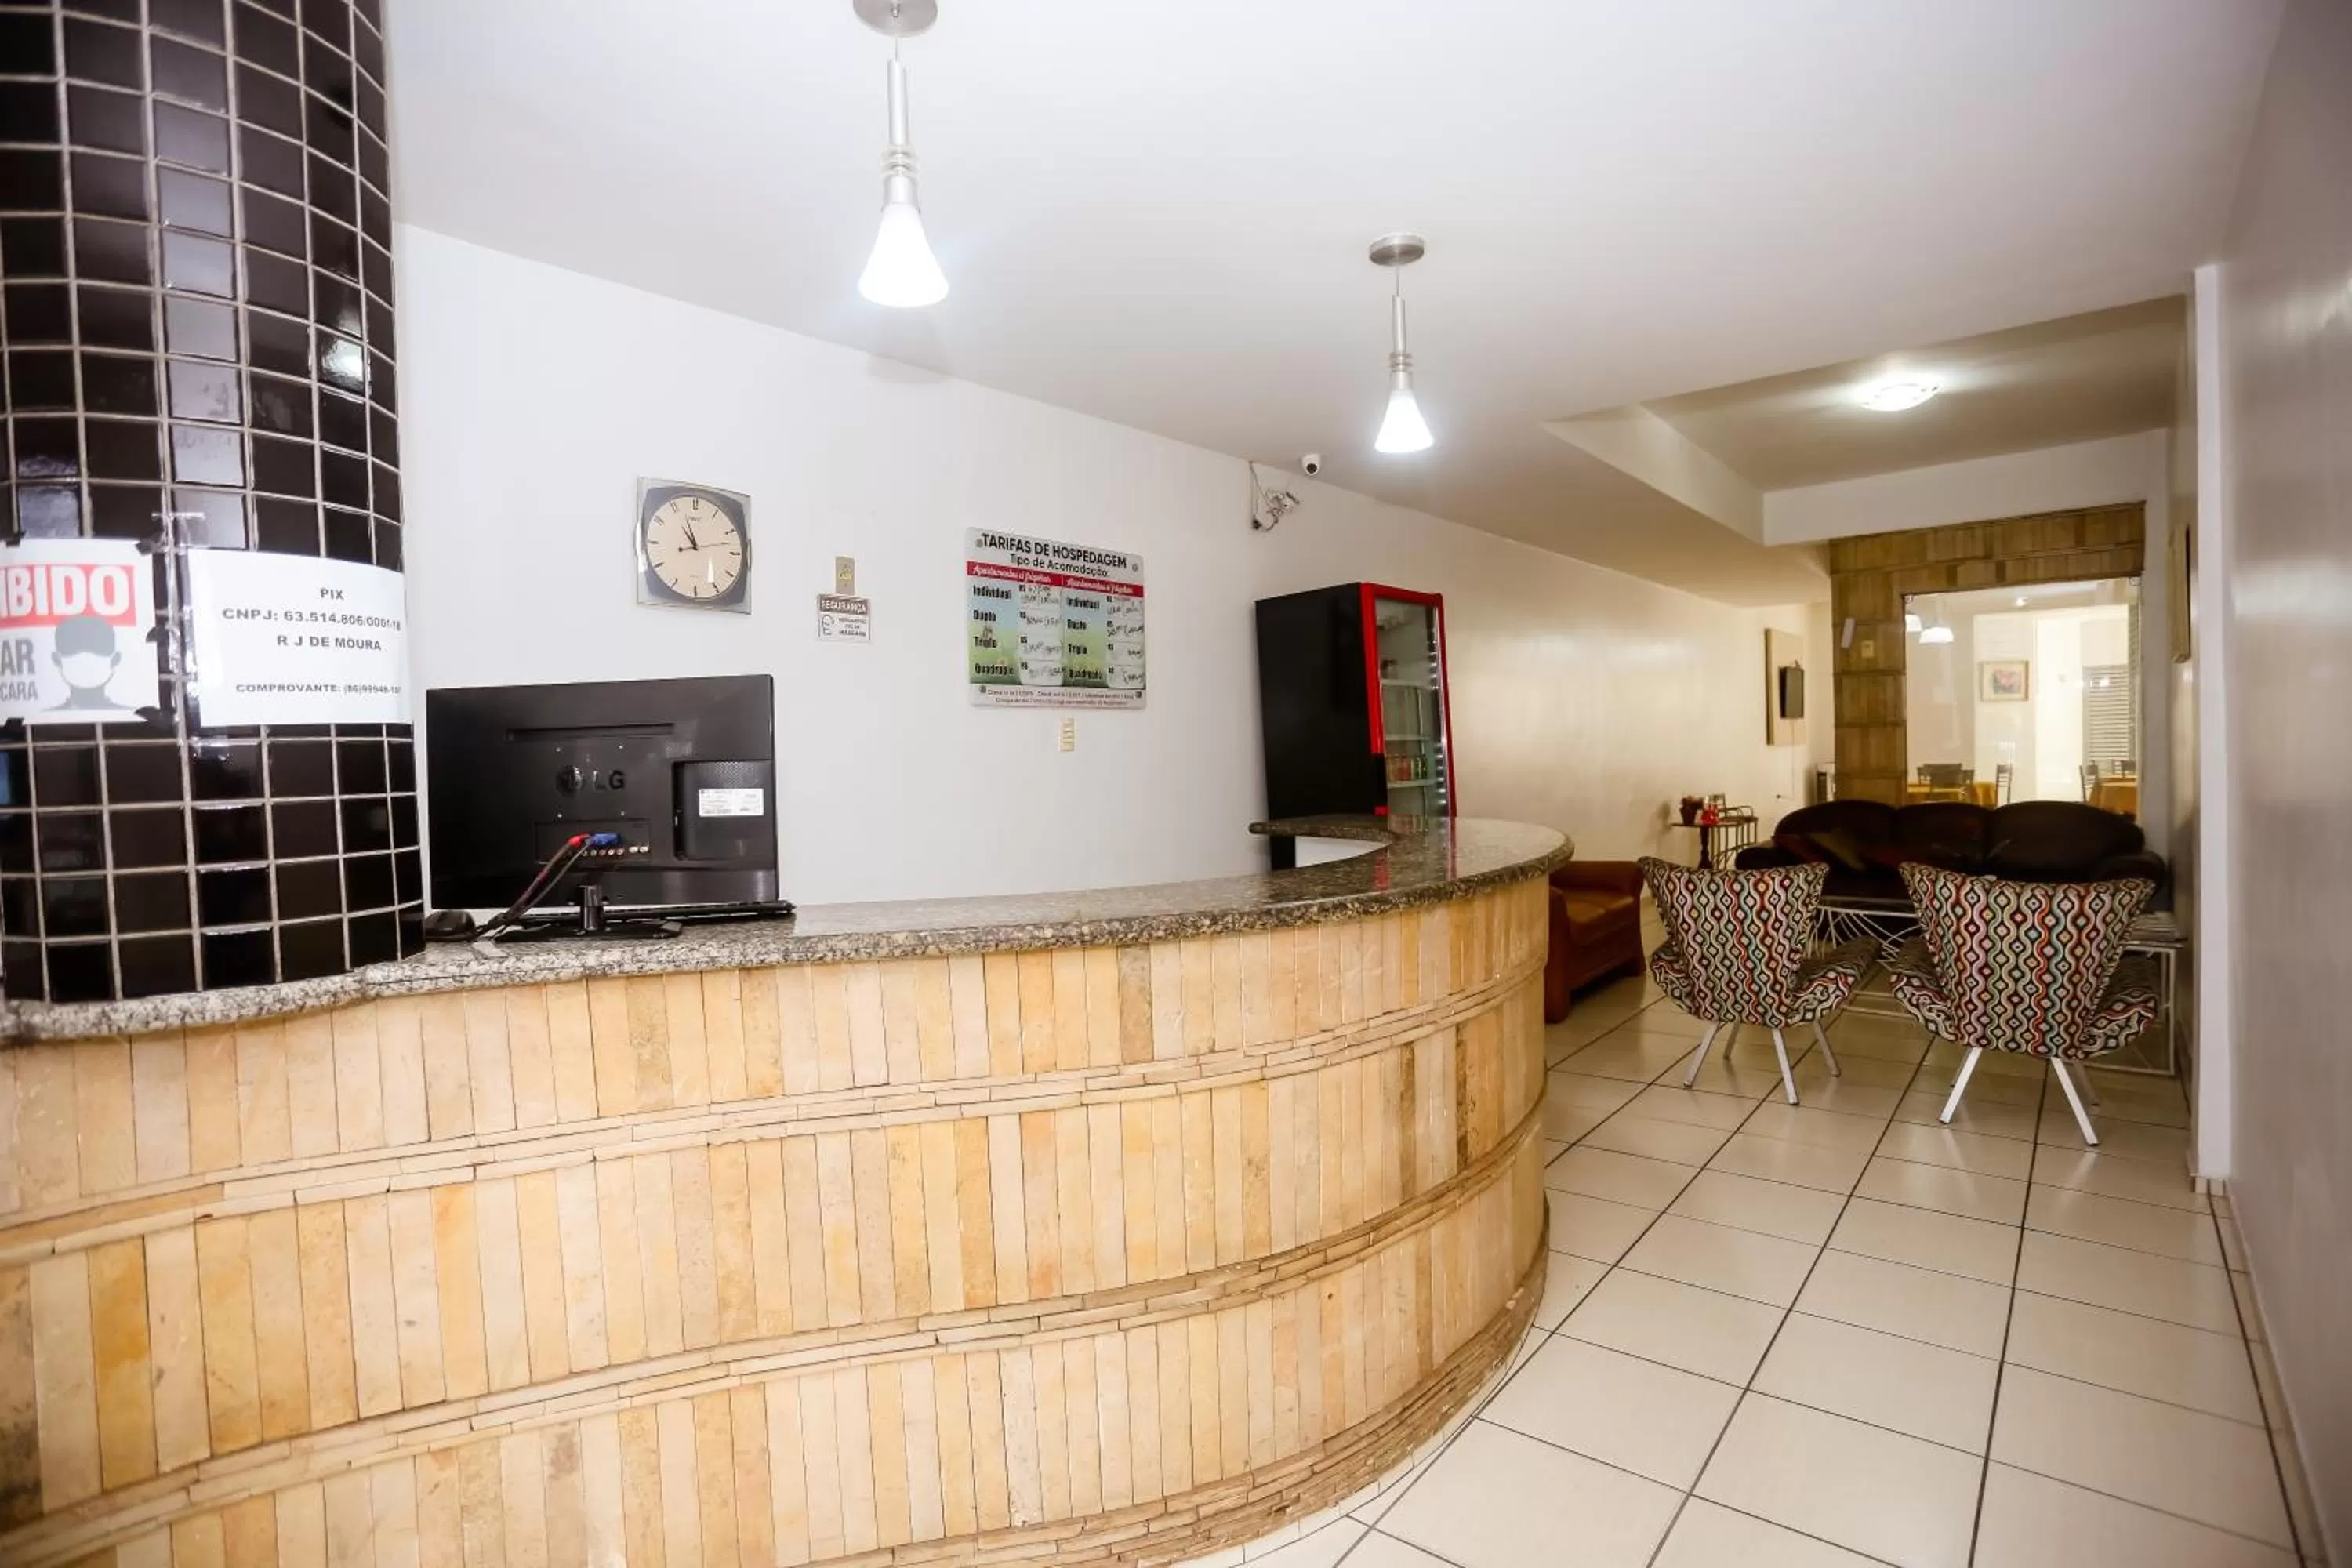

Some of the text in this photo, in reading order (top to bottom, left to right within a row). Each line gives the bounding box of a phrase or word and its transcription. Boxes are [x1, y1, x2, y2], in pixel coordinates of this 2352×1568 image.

[982, 533, 1127, 569] TARIFAS DE HOSPEDAGEM
[1010, 553, 1030, 566] Tipo
[1033, 557, 1045, 568] de
[1047, 559, 1108, 578] Acomodação
[320, 588, 344, 601] PIX
[973, 584, 1012, 600] Individual
[222, 608, 278, 621] CNPJ:
[277, 635, 381, 651] R J DE MOURA
[0, 639, 36, 676] AR
[0, 681, 38, 702] CARA
[235, 684, 341, 693] COMPROVANTE:
[592, 769, 625, 790] LG
